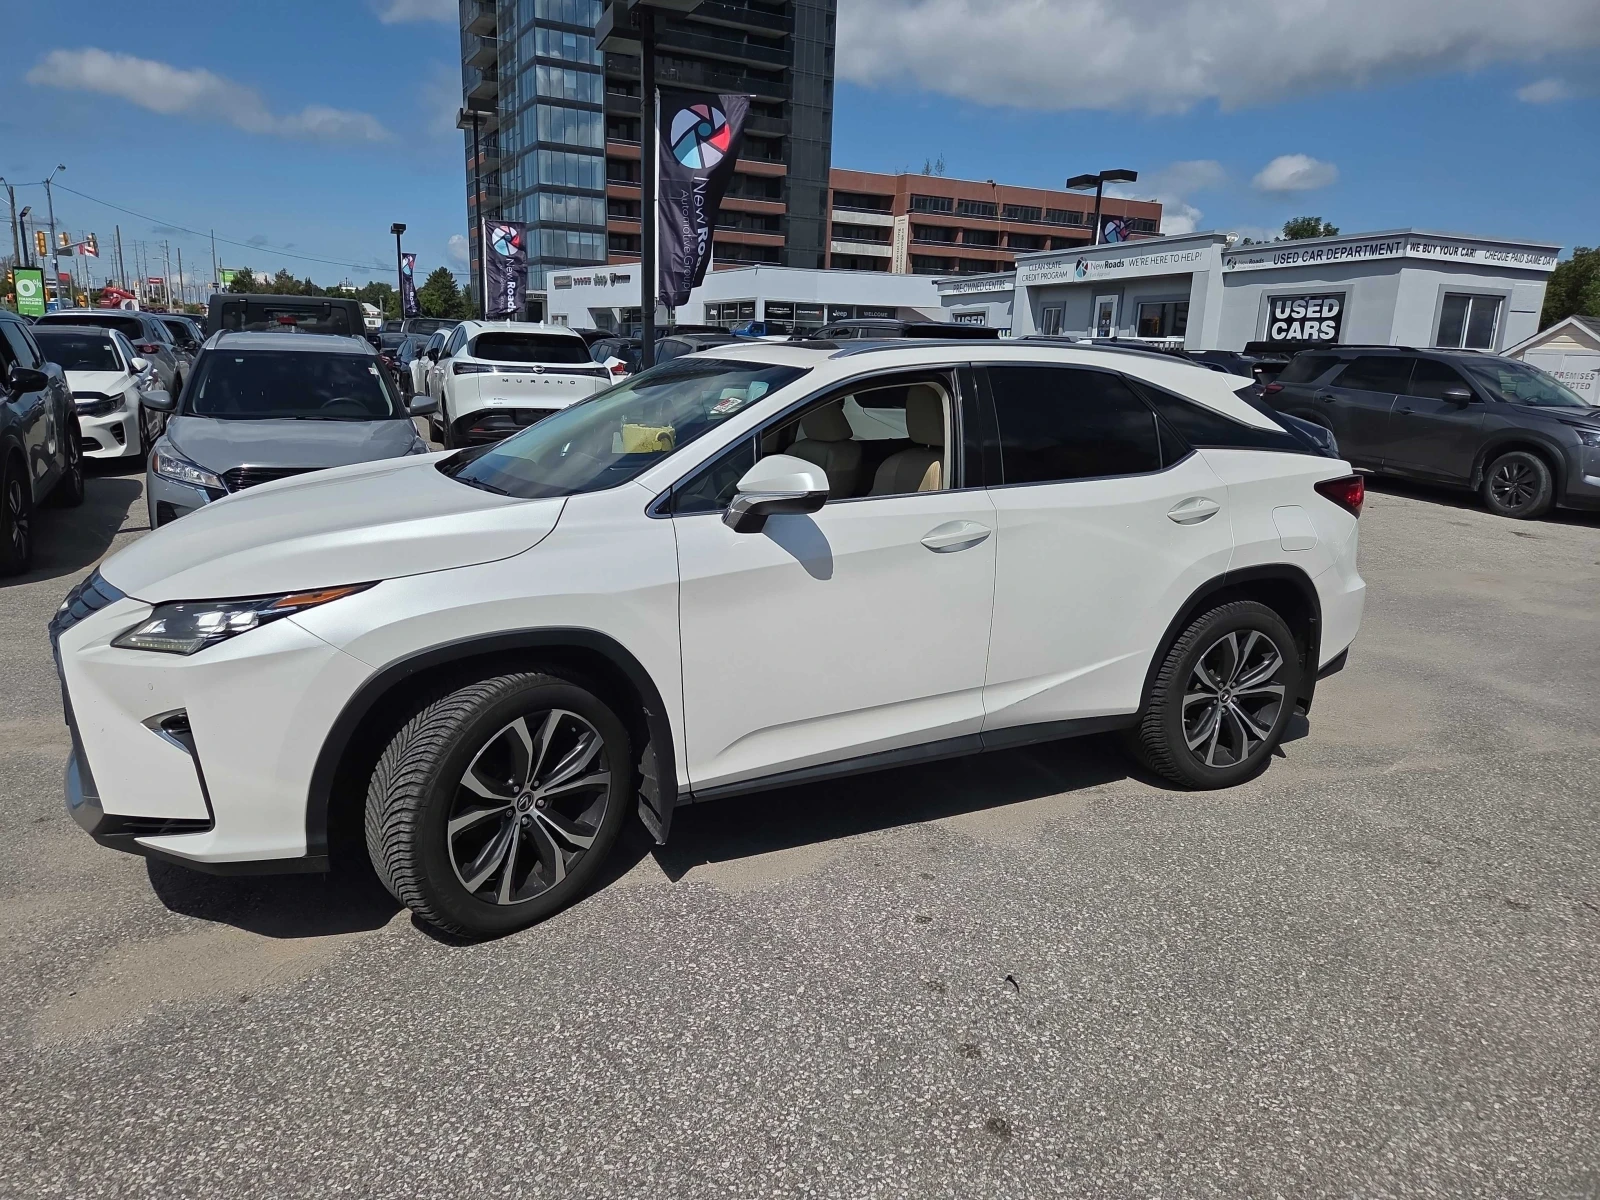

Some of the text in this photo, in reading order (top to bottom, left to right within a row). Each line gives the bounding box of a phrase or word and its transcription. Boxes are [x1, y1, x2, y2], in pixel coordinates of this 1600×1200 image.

[693, 176, 710, 282] NewRo
[680, 189, 694, 290] Automotive Group
[1090, 252, 1203, 271] NewRoads WE'RE HERE TO HELP!
[1273, 241, 1402, 265] USED CAR DEPARTMENT
[1409, 241, 1556, 266] WE BUY YOUR CAR! CHEQUE PAID SAME DAY
[1028, 261, 1062, 272] CLEAN SLATE
[506, 258, 517, 312] NewRoads
[1021, 270, 1068, 282] CREDIT PROGRAM
[16, 279, 42, 296] 0%
[953, 279, 1006, 293] PRE-OWNED CENTRE
[832, 309, 848, 318] Jeep
[1275, 298, 1340, 319] USED
[957, 315, 985, 325] USED
[998, 329, 1011, 338] ALE
[1271, 320, 1336, 340] CARS
[1553, 371, 1596, 380] PREMISES
